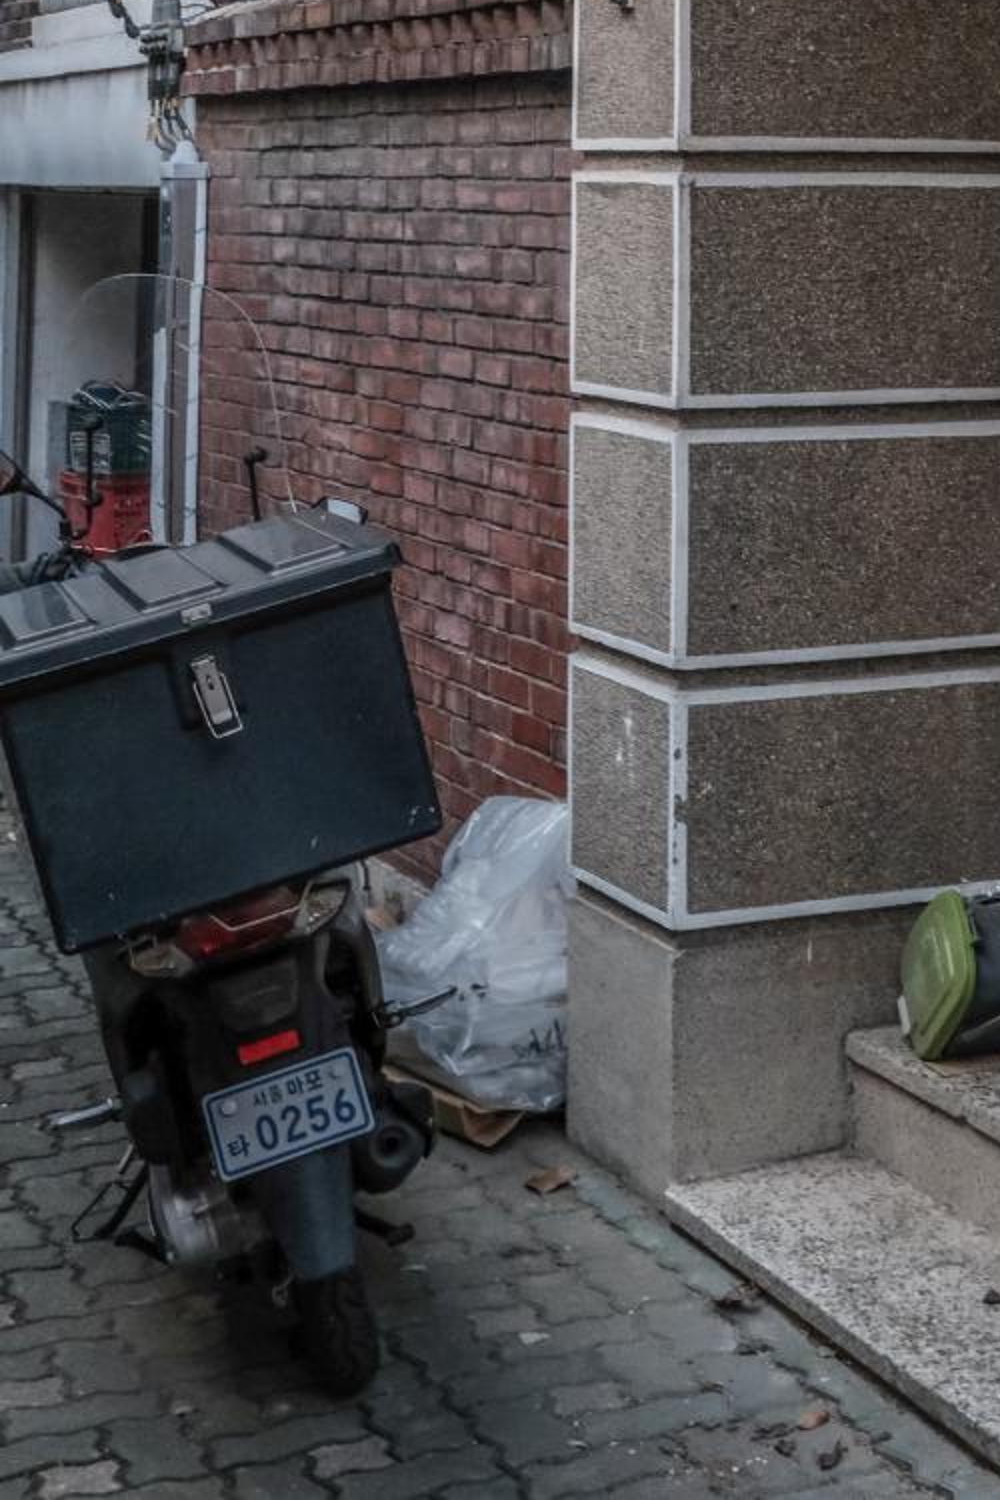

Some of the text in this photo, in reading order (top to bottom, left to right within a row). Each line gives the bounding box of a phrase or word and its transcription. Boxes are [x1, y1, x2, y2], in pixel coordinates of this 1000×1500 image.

[286, 1070, 323, 1095] 마포
[227, 1088, 356, 1156] 타 0256
